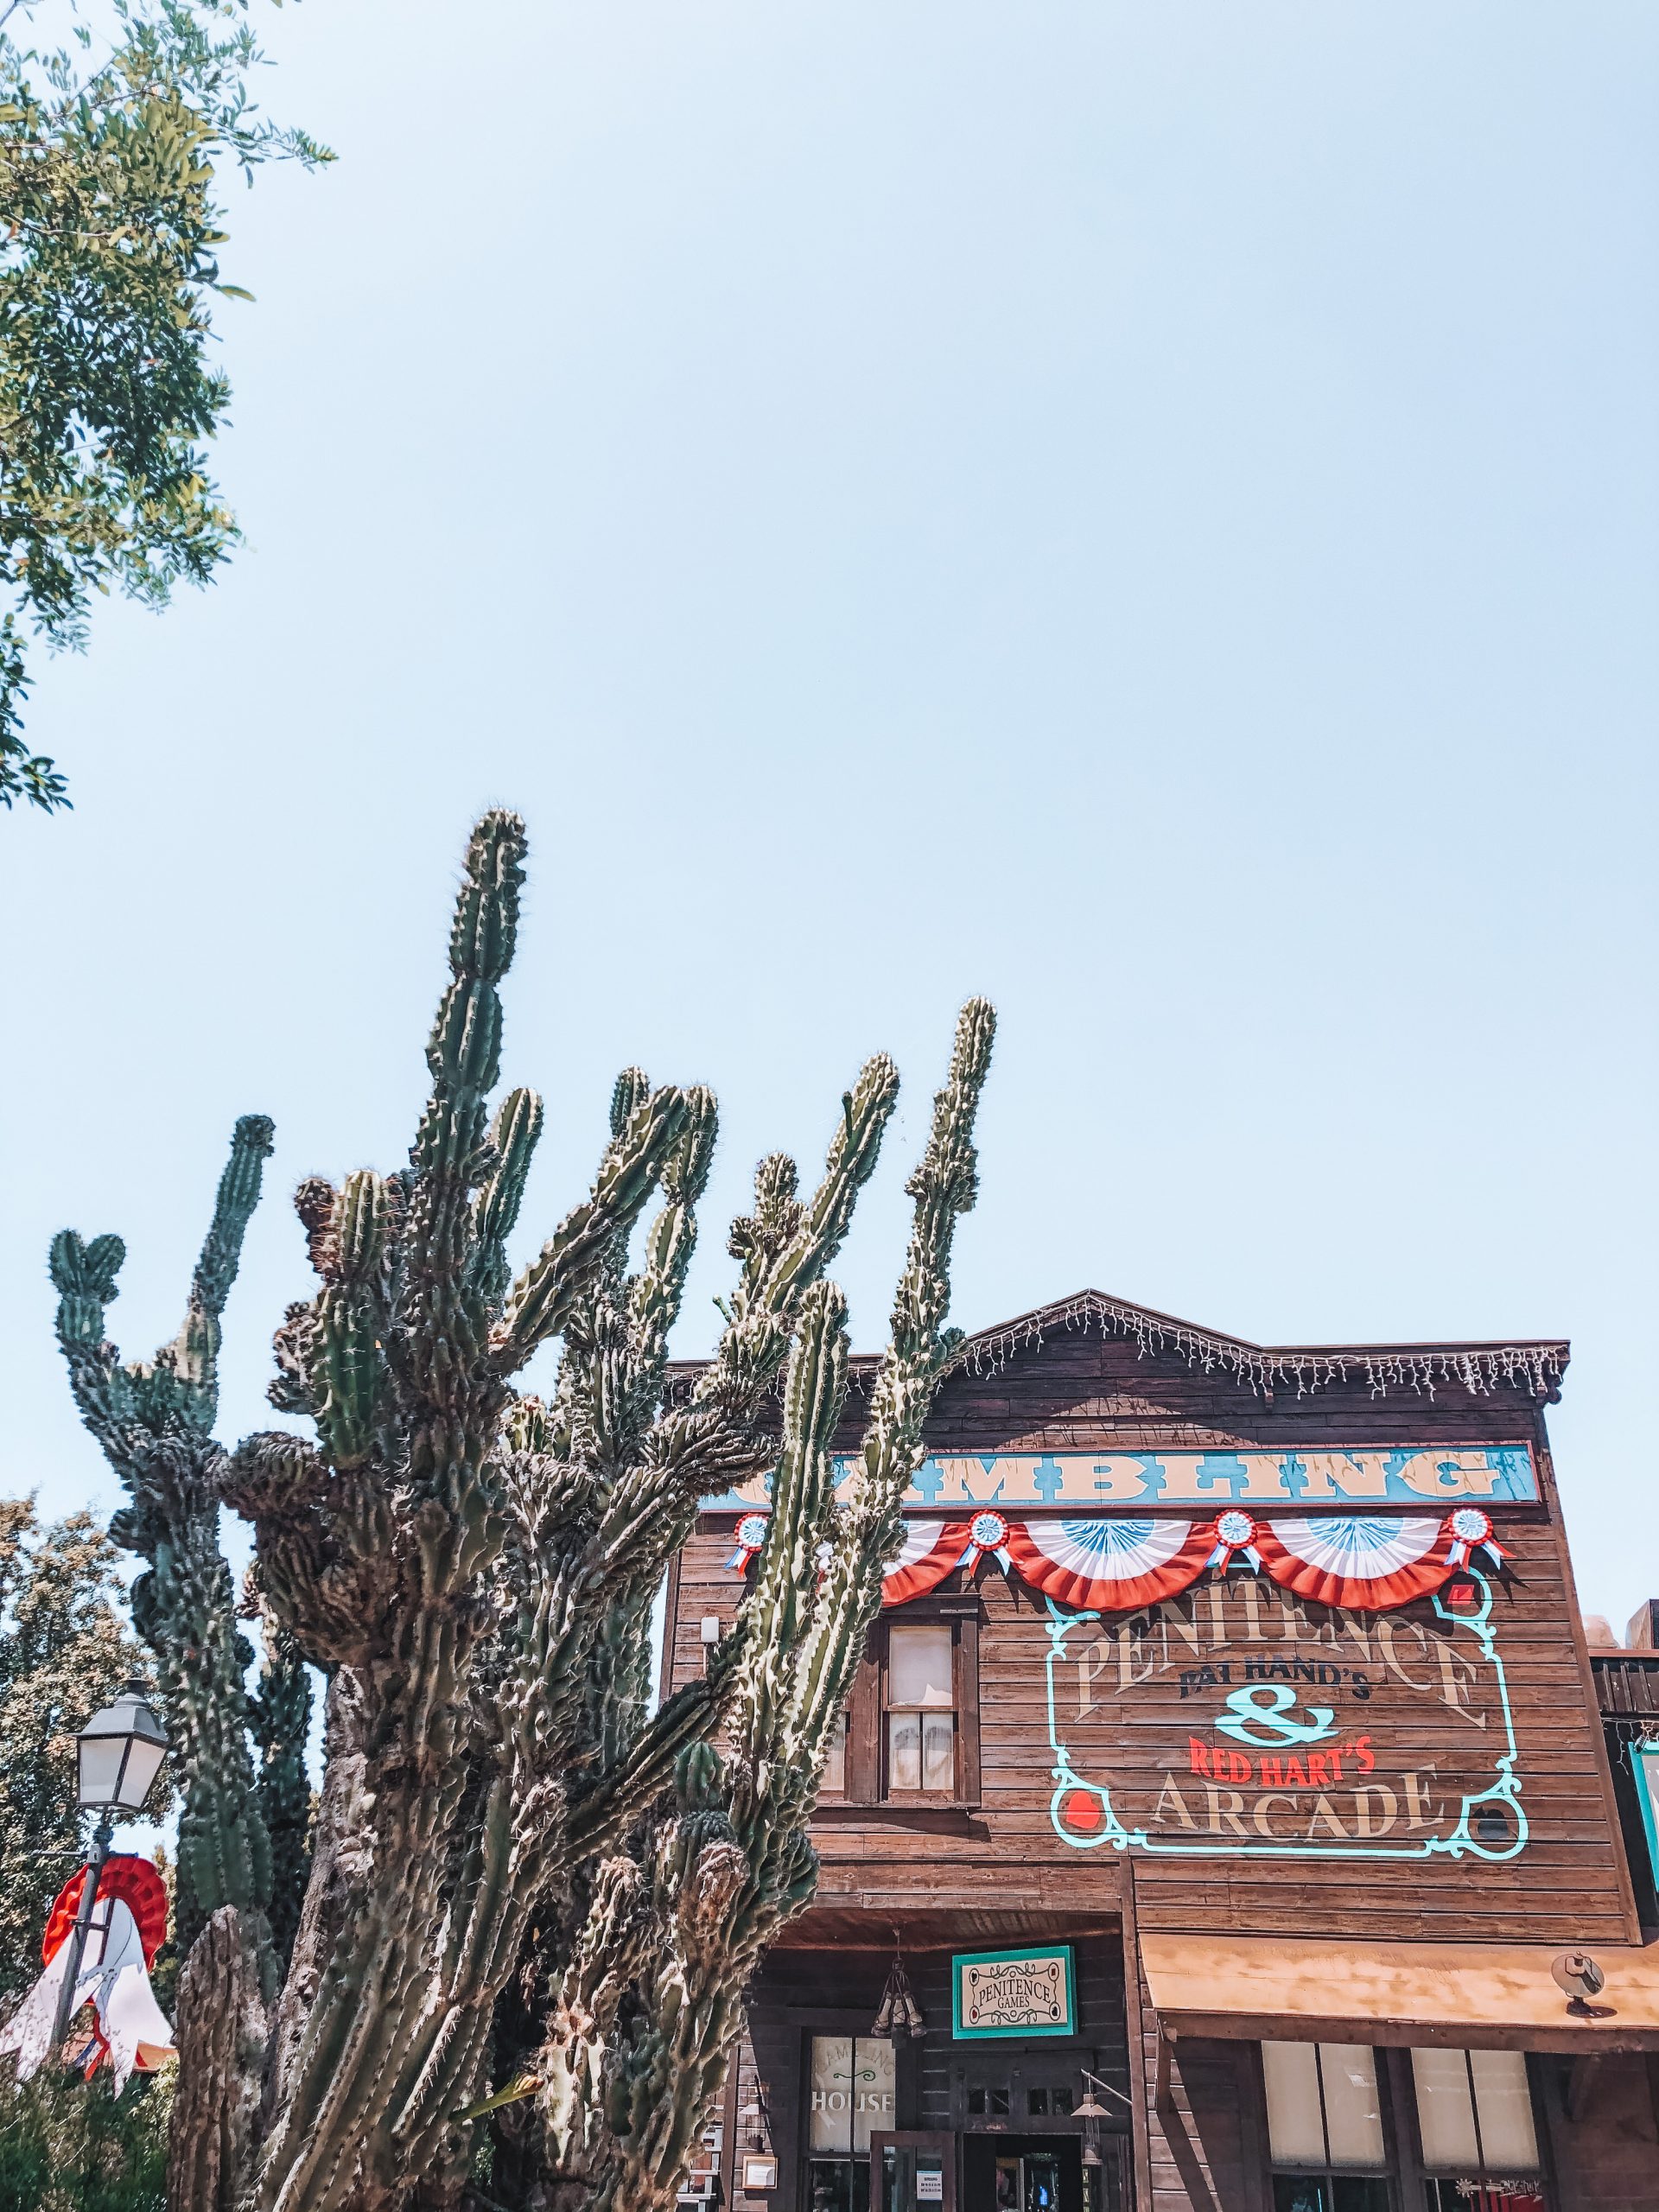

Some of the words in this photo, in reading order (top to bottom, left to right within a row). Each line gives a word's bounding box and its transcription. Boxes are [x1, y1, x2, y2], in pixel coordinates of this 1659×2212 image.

[733, 1451, 1500, 1504] MBLING
[1074, 1570, 1486, 1730] PENITENCE
[1179, 1657, 1233, 1700] PAT
[1244, 1654, 1370, 1700] HAND'S
[1214, 1684, 1340, 1747] &
[1189, 1735, 1252, 1783] RED
[1259, 1735, 1376, 1788] HART'S
[1149, 1763, 1445, 1842] ARCADE
[979, 1979, 1052, 2008] PENITENCE
[997, 1995, 1031, 2010] GAMES
[811, 2091, 893, 2113] HOUSE
